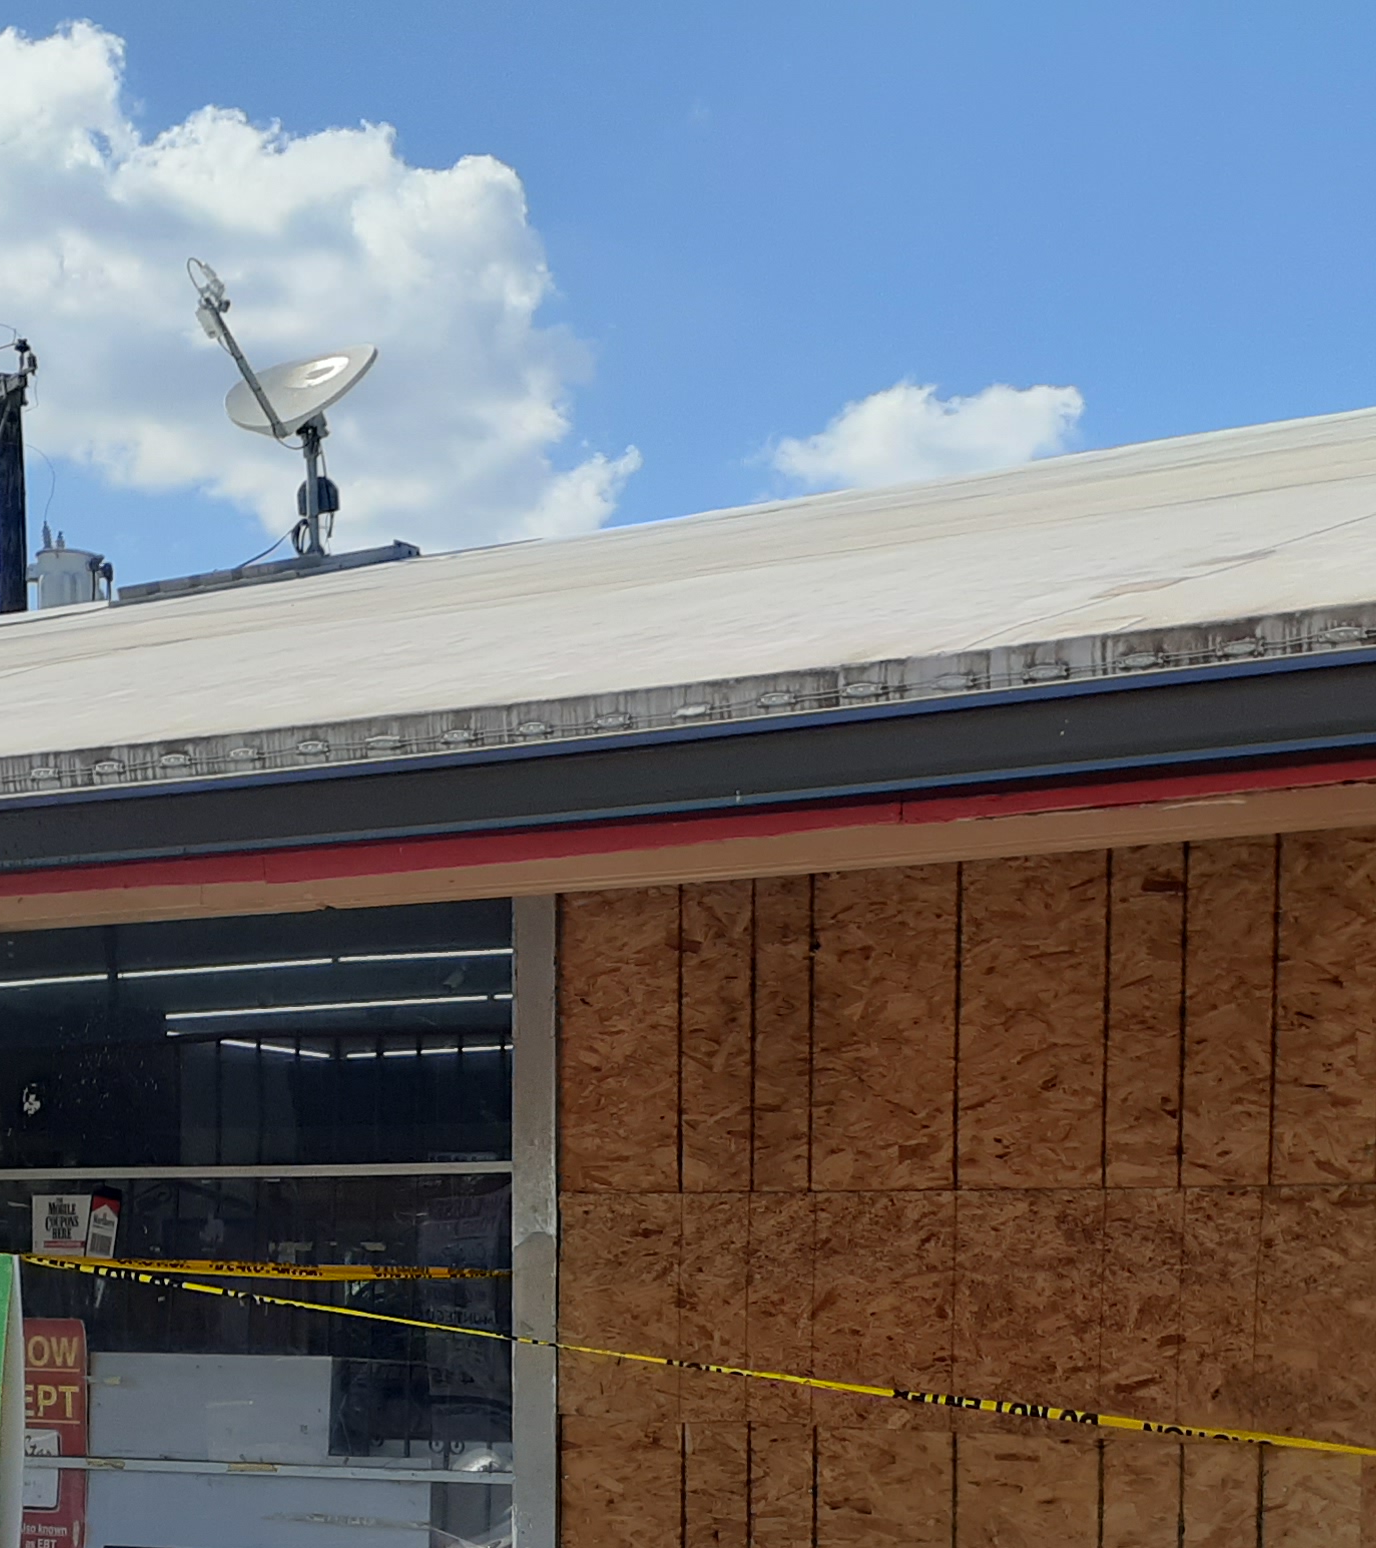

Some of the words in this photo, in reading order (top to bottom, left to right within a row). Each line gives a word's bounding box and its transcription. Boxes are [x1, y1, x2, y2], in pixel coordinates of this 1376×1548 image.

[45, 1216, 79, 1232] COUPONS
[52, 1228, 72, 1239] HERE
[26, 1335, 80, 1369] OW
[38, 1525, 67, 1537] known
